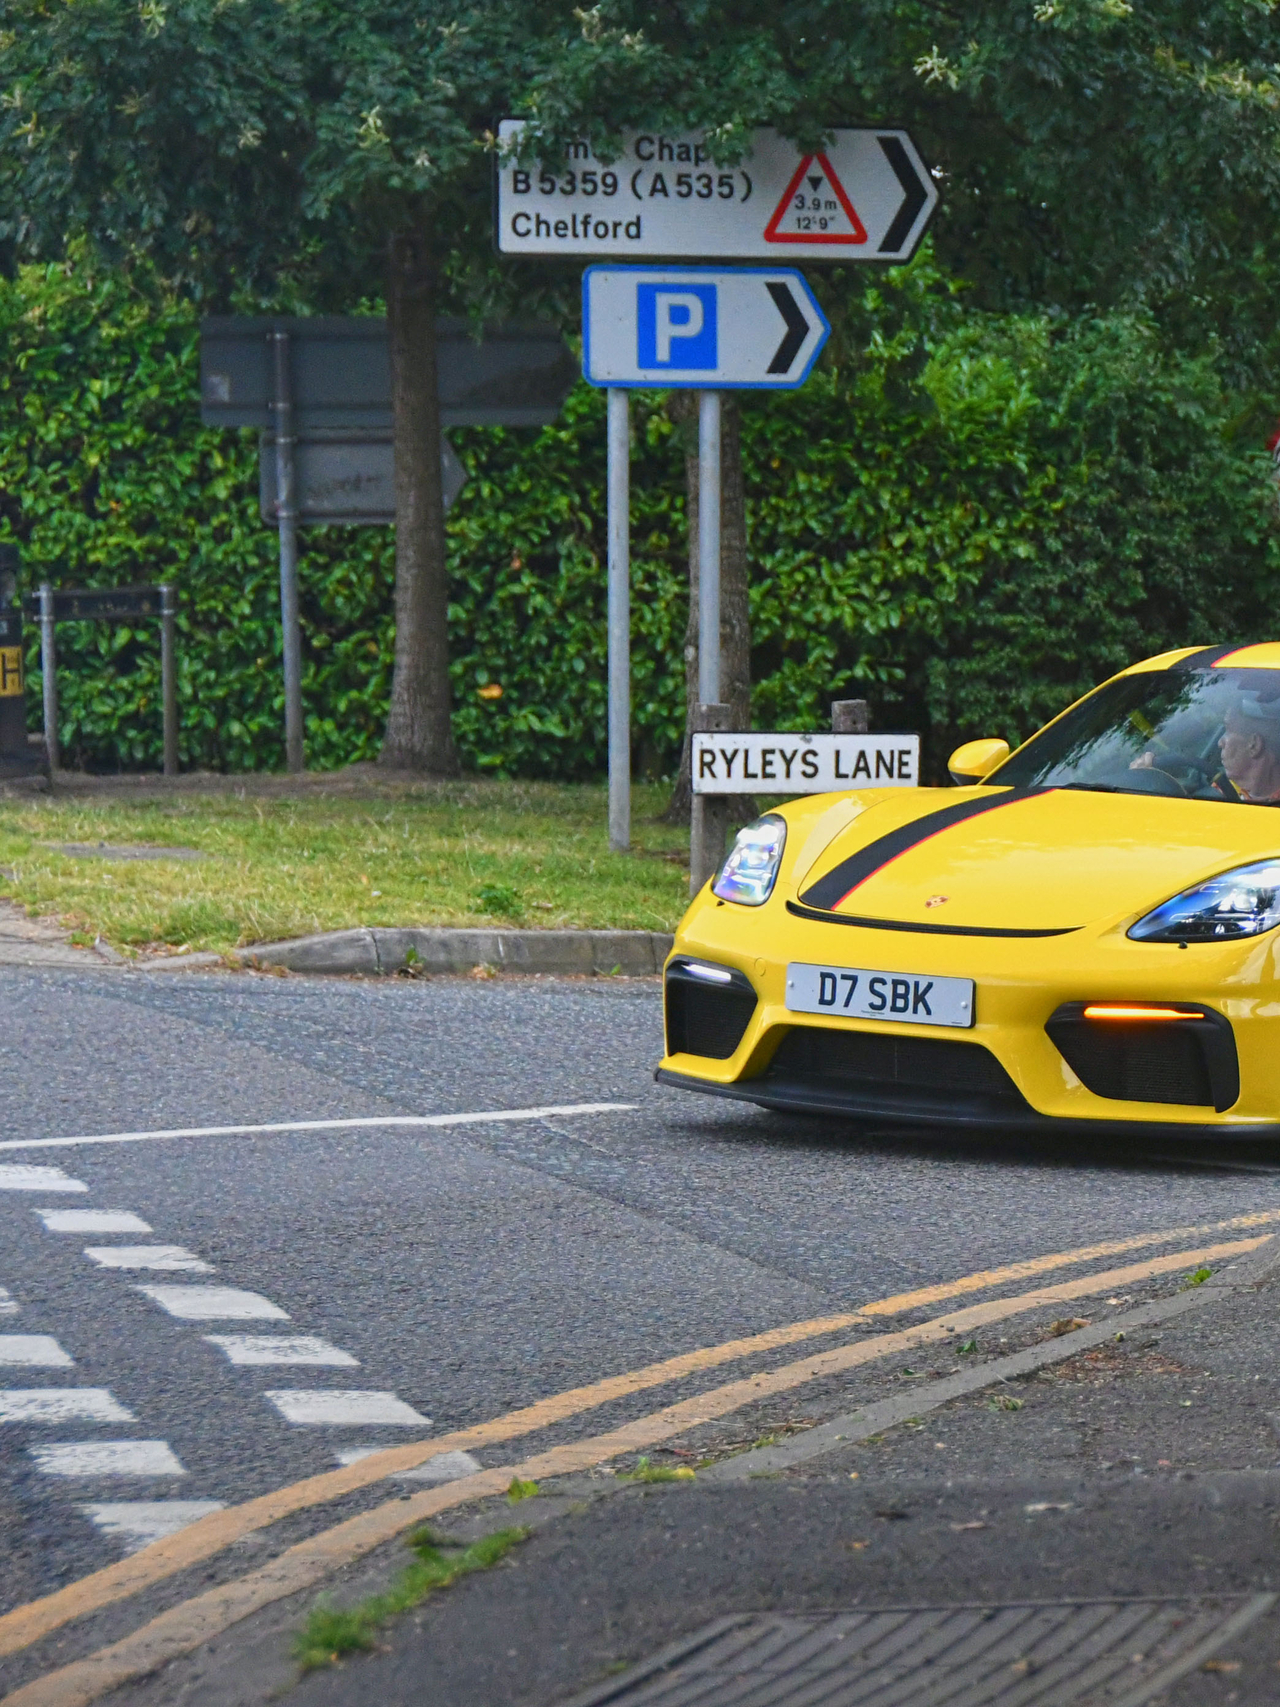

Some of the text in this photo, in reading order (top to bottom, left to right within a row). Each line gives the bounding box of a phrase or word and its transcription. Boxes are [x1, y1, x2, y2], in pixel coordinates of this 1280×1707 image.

[634, 134, 713, 167] Chap
[511, 211, 642, 240] Chelford
[655, 292, 705, 363] P
[699, 748, 912, 780] RYLEYS LANE
[818, 971, 934, 1016] D7 SBK
